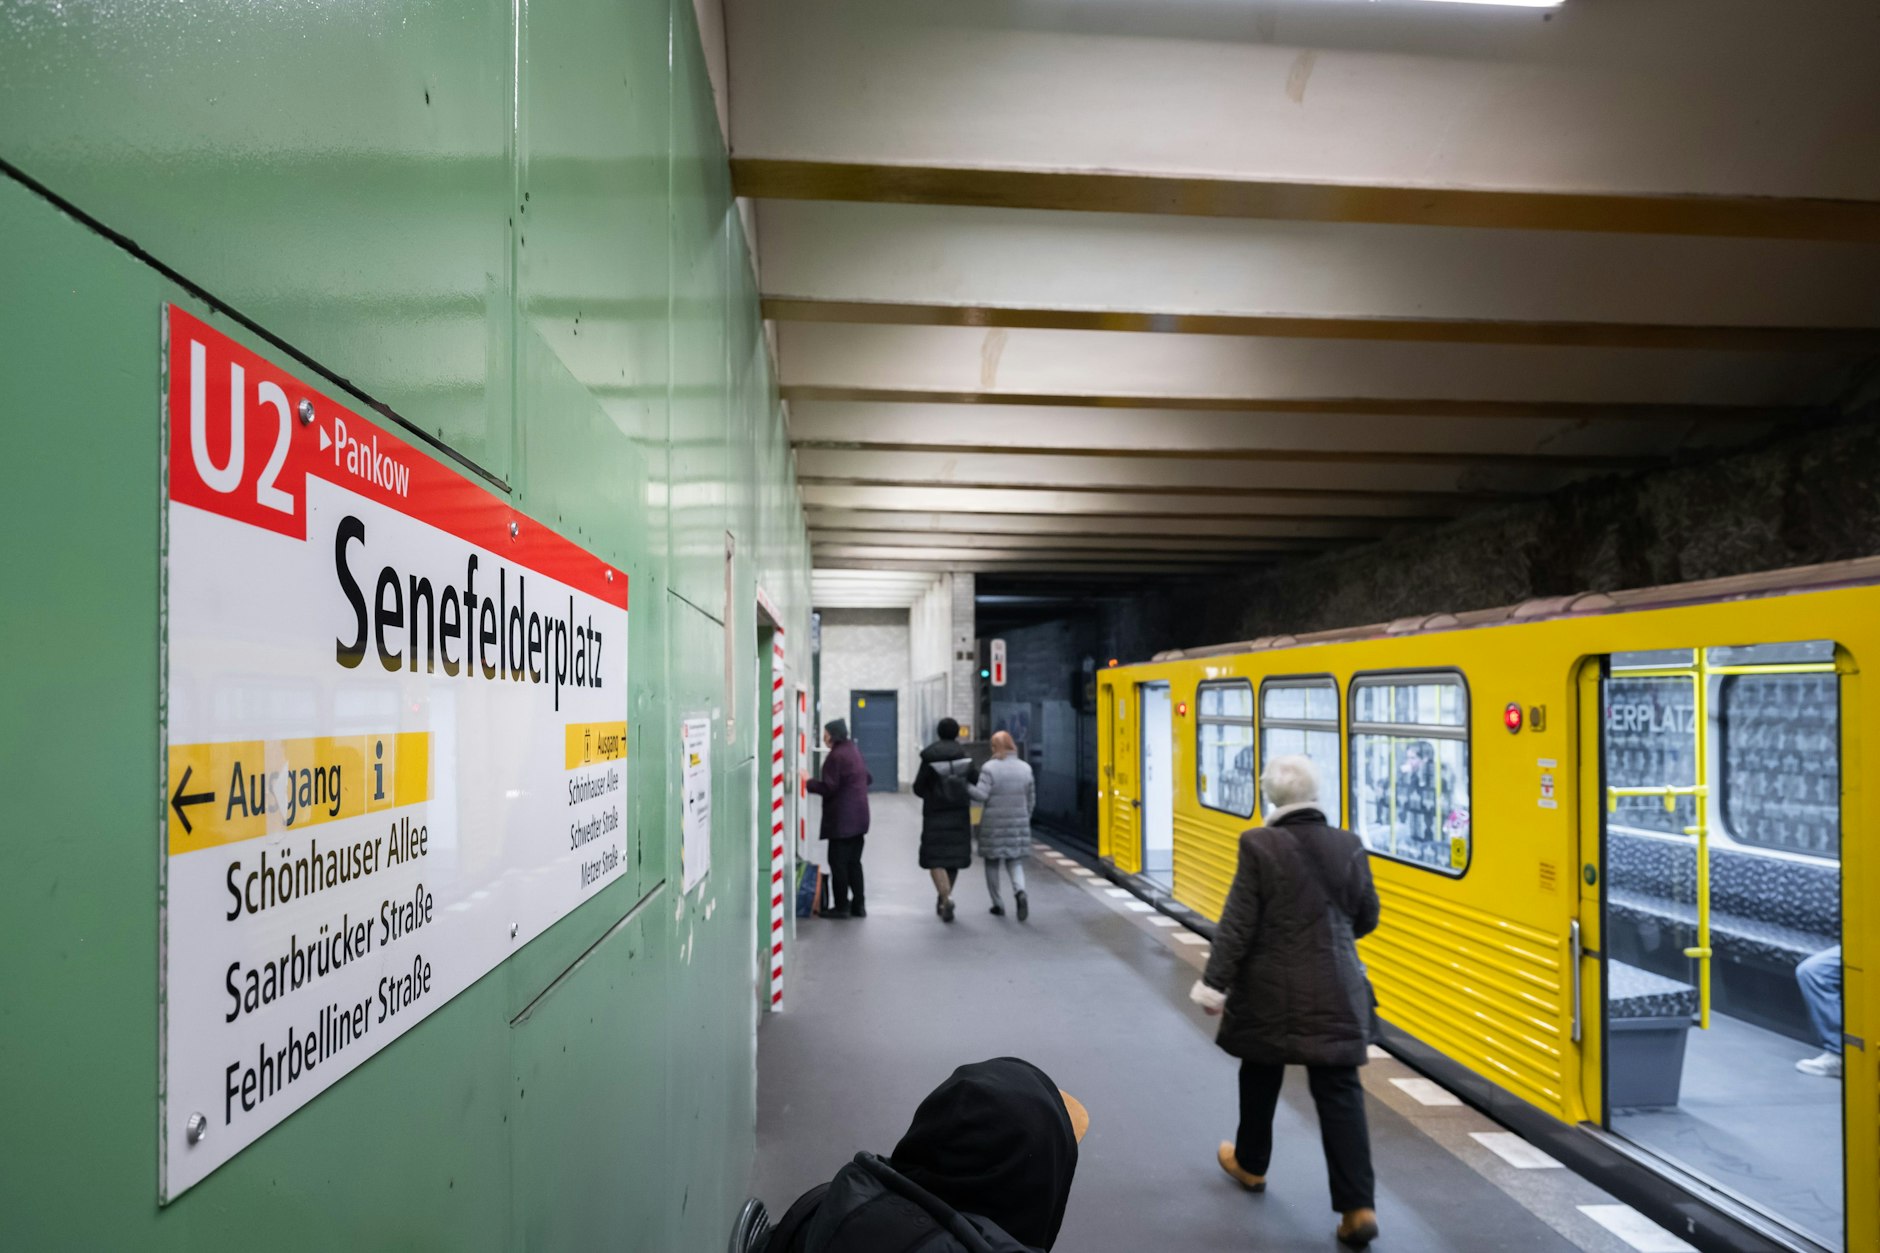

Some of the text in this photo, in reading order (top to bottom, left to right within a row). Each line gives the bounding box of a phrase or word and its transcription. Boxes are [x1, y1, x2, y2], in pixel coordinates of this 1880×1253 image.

[190, 338, 295, 516] U2
[334, 416, 410, 499] Pankow
[334, 515, 603, 712] Senefelderplatz
[568, 767, 619, 806] Schönhauser Allee
[597, 730, 619, 760] Ausgang
[225, 760, 342, 827] Ausgang
[570, 804, 618, 852] Schwedter Straße
[226, 816, 429, 922] Schönhauser Allee
[580, 843, 618, 890] Metzer Straße
[225, 882, 434, 1024] Saarbrücker Straße
[225, 953, 432, 1126] Fehrbelliner Straße
